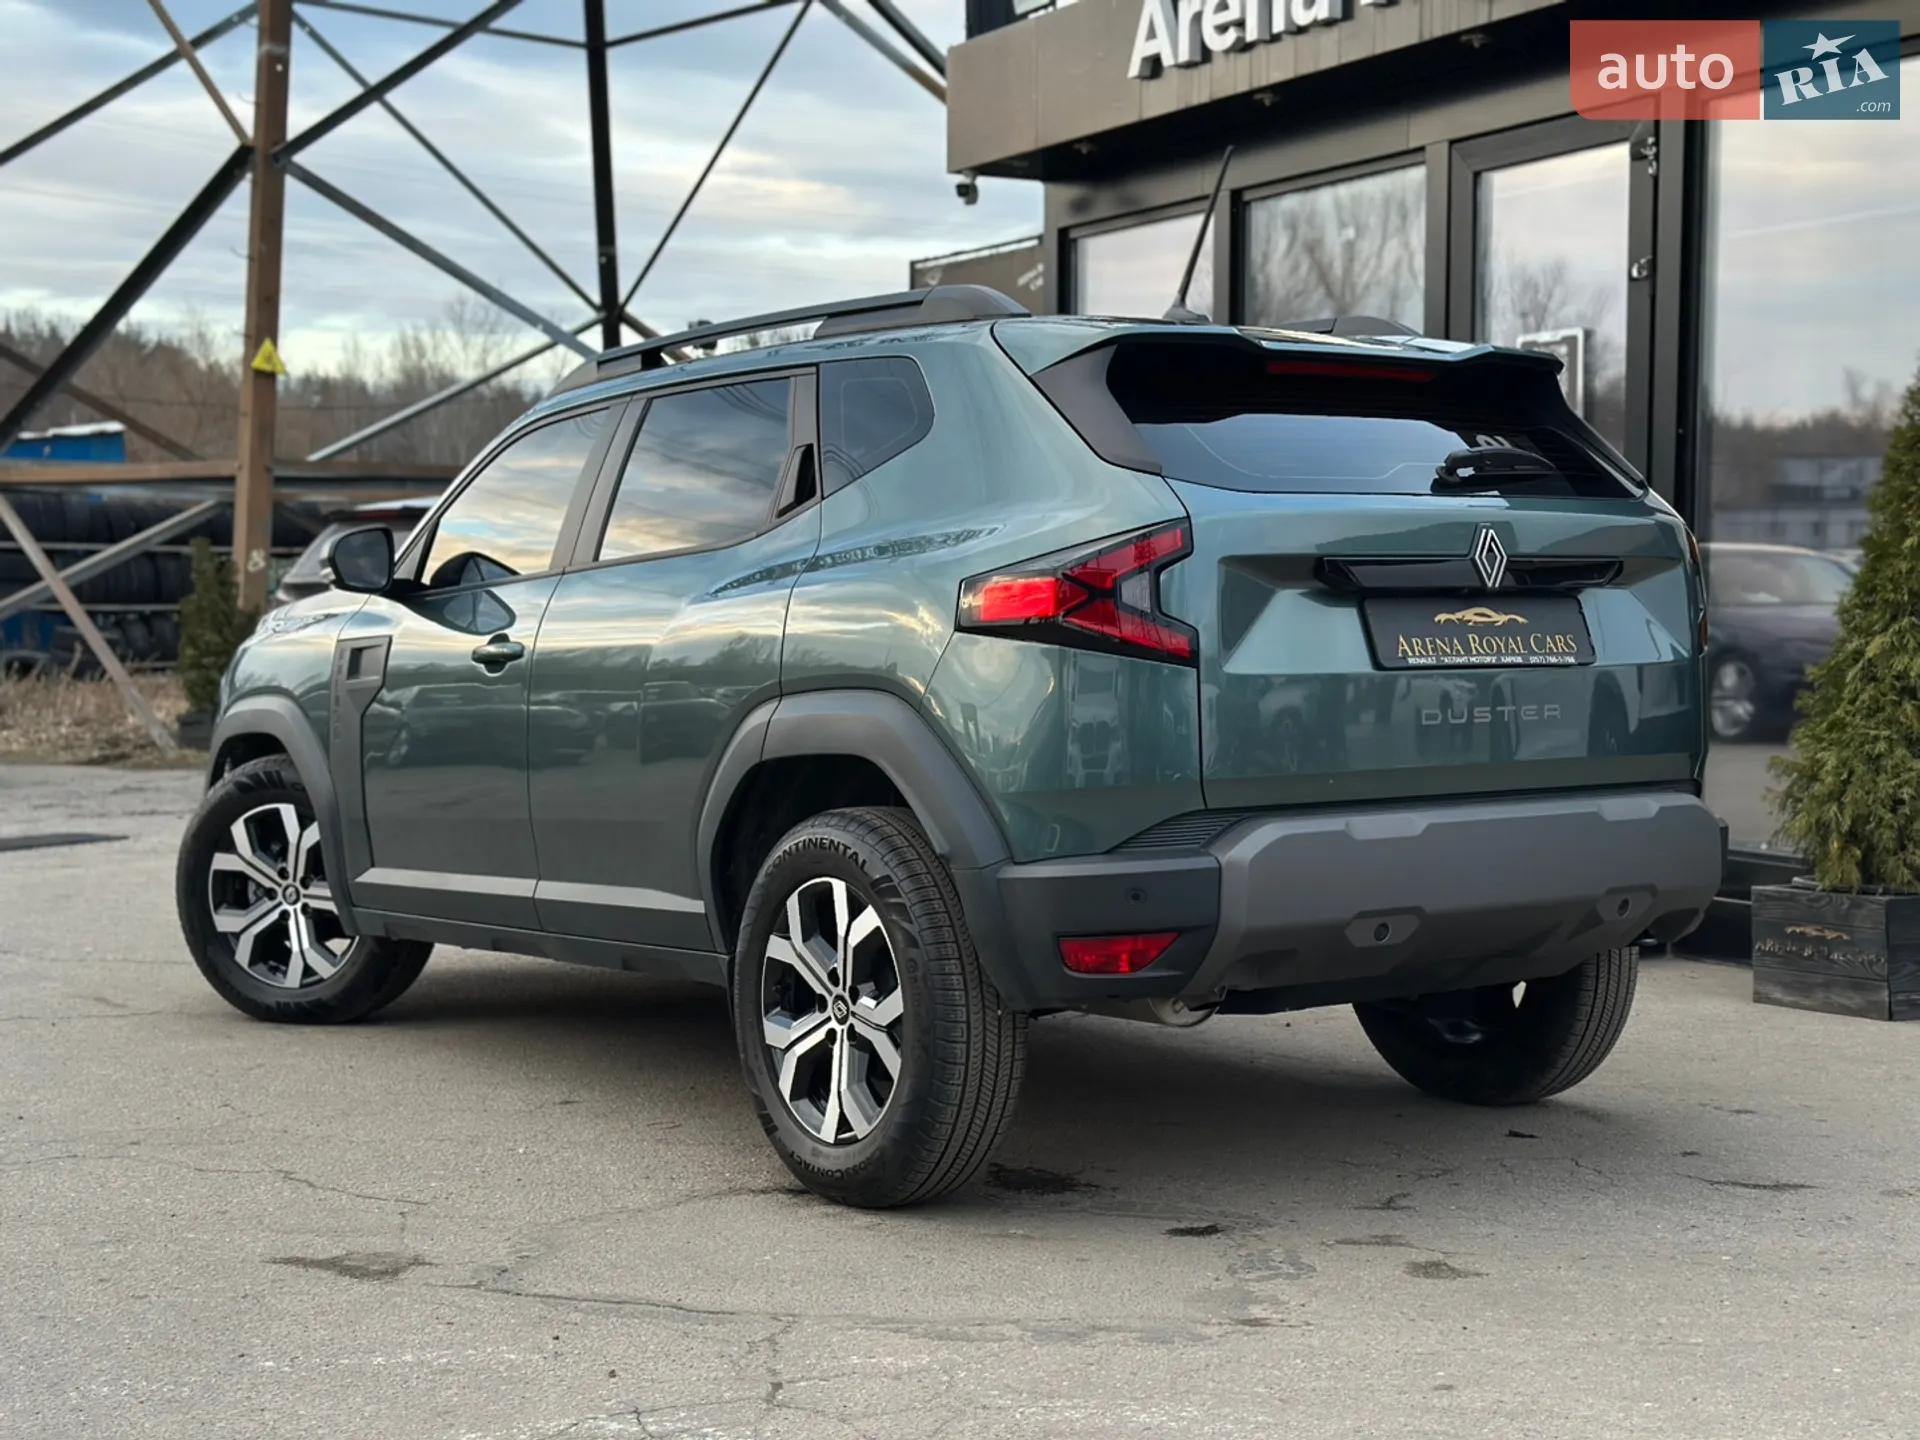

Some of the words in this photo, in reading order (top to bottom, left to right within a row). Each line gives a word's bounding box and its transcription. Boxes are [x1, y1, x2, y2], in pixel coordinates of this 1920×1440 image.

[1397, 633, 1465, 657] ARENA
[1467, 633, 1528, 655] ROYAL
[1530, 633, 1577, 654] CARS
[1421, 704, 1562, 726] DUSTER
[764, 836, 870, 876] CONTINENTAL
